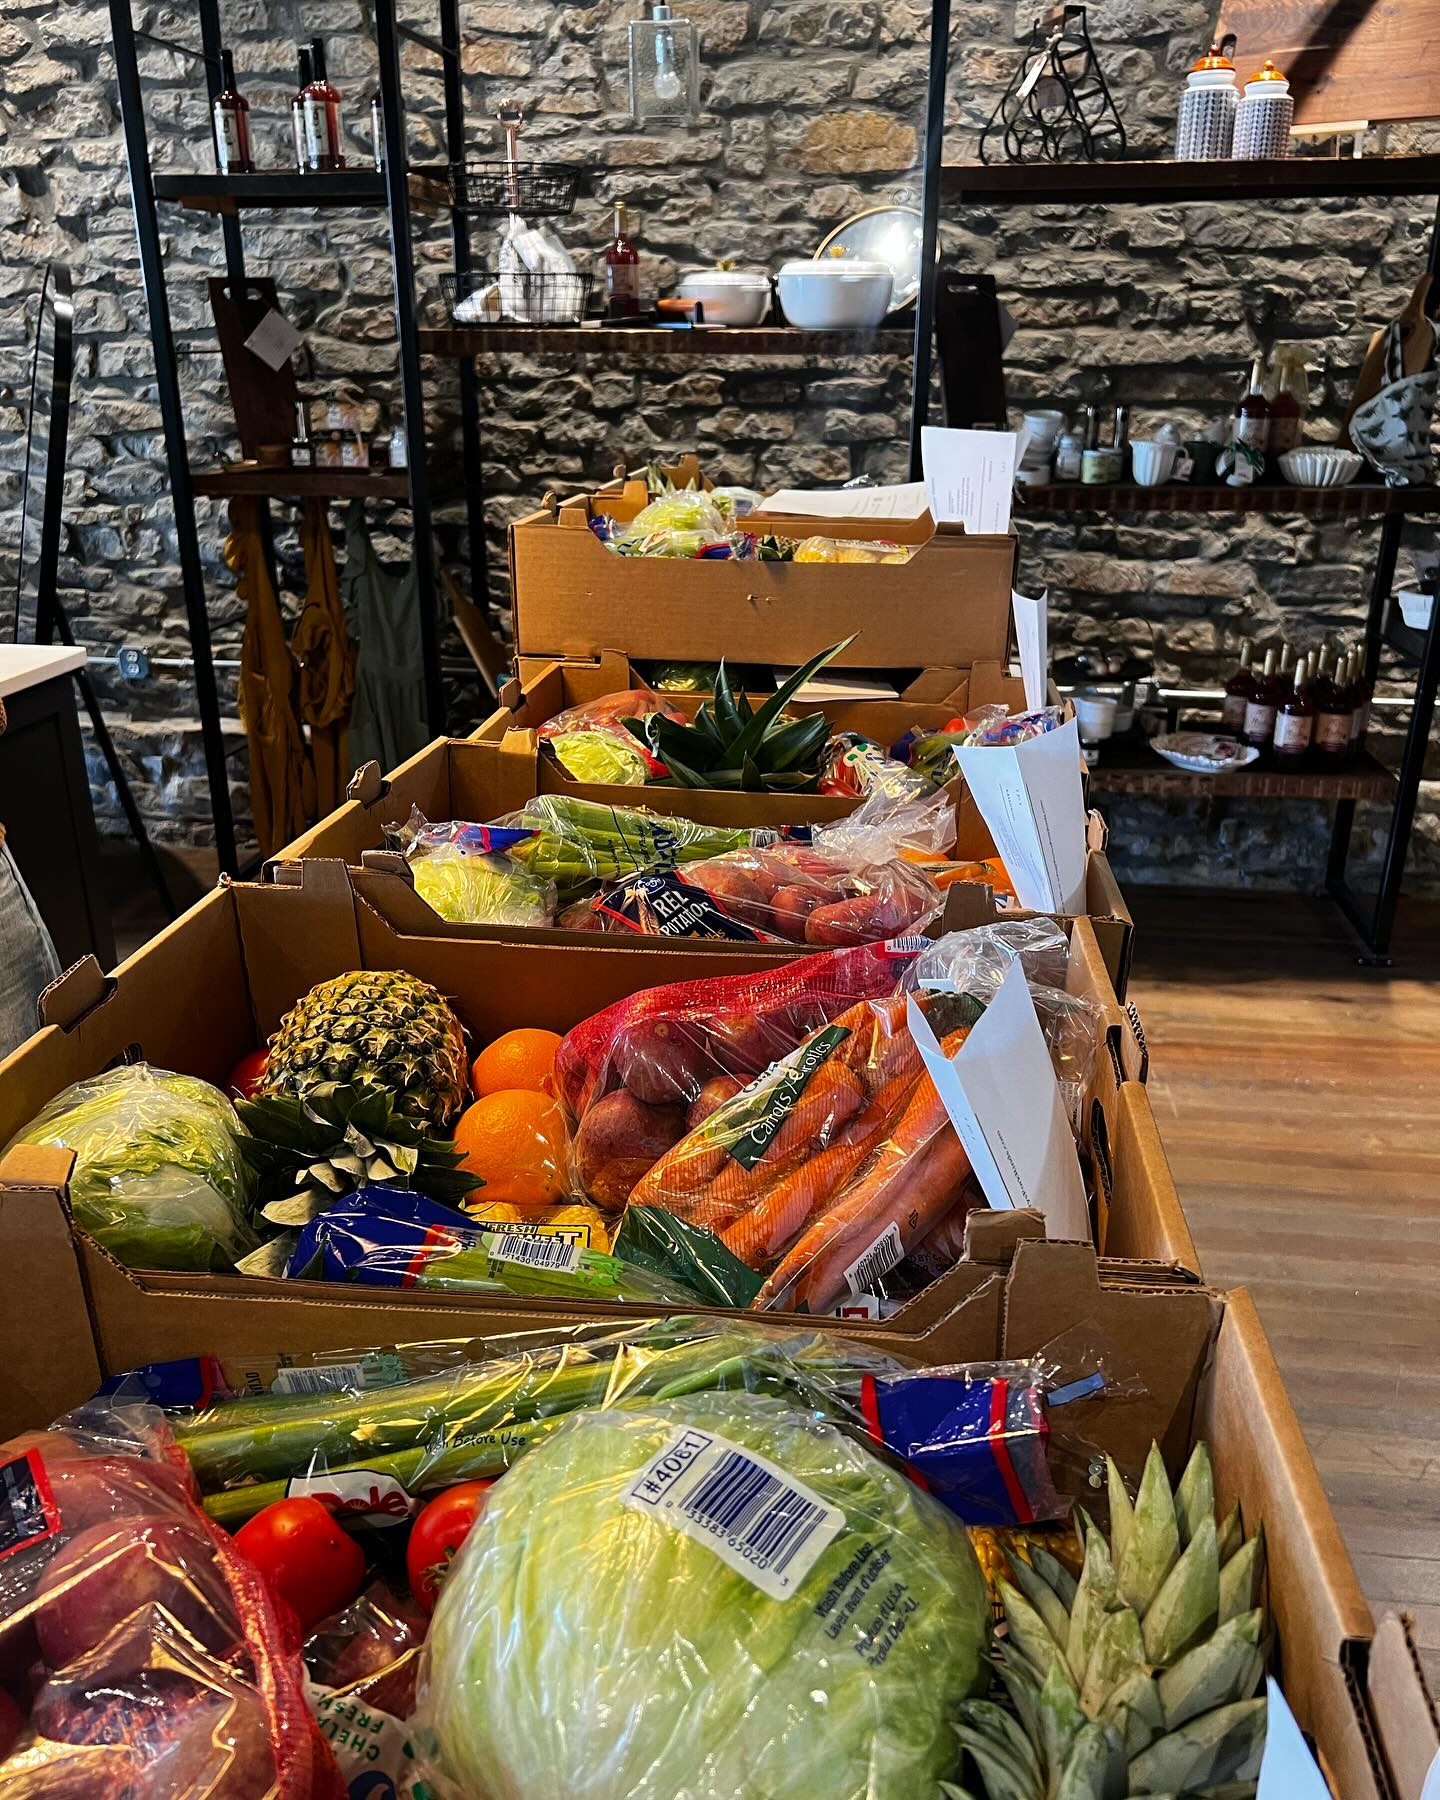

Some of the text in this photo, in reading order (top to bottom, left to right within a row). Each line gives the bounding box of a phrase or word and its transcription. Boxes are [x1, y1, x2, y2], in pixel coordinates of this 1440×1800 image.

[750, 1091, 793, 1145] Carrots
[788, 1040, 832, 1084] Crottes
[488, 1223, 536, 1233] FRESH
[504, 1252, 531, 1265] 71430
[534, 1259, 561, 1269] 04979
[452, 1432, 496, 1449] Before
[501, 1432, 526, 1447] Use
[643, 1440, 701, 1495] #4061
[311, 1486, 409, 1517] Dole
[686, 1510, 727, 1538] 33383
[727, 1537, 769, 1570] 65020
[854, 1541, 873, 1563] Use
[317, 1693, 385, 1735] FRESH
